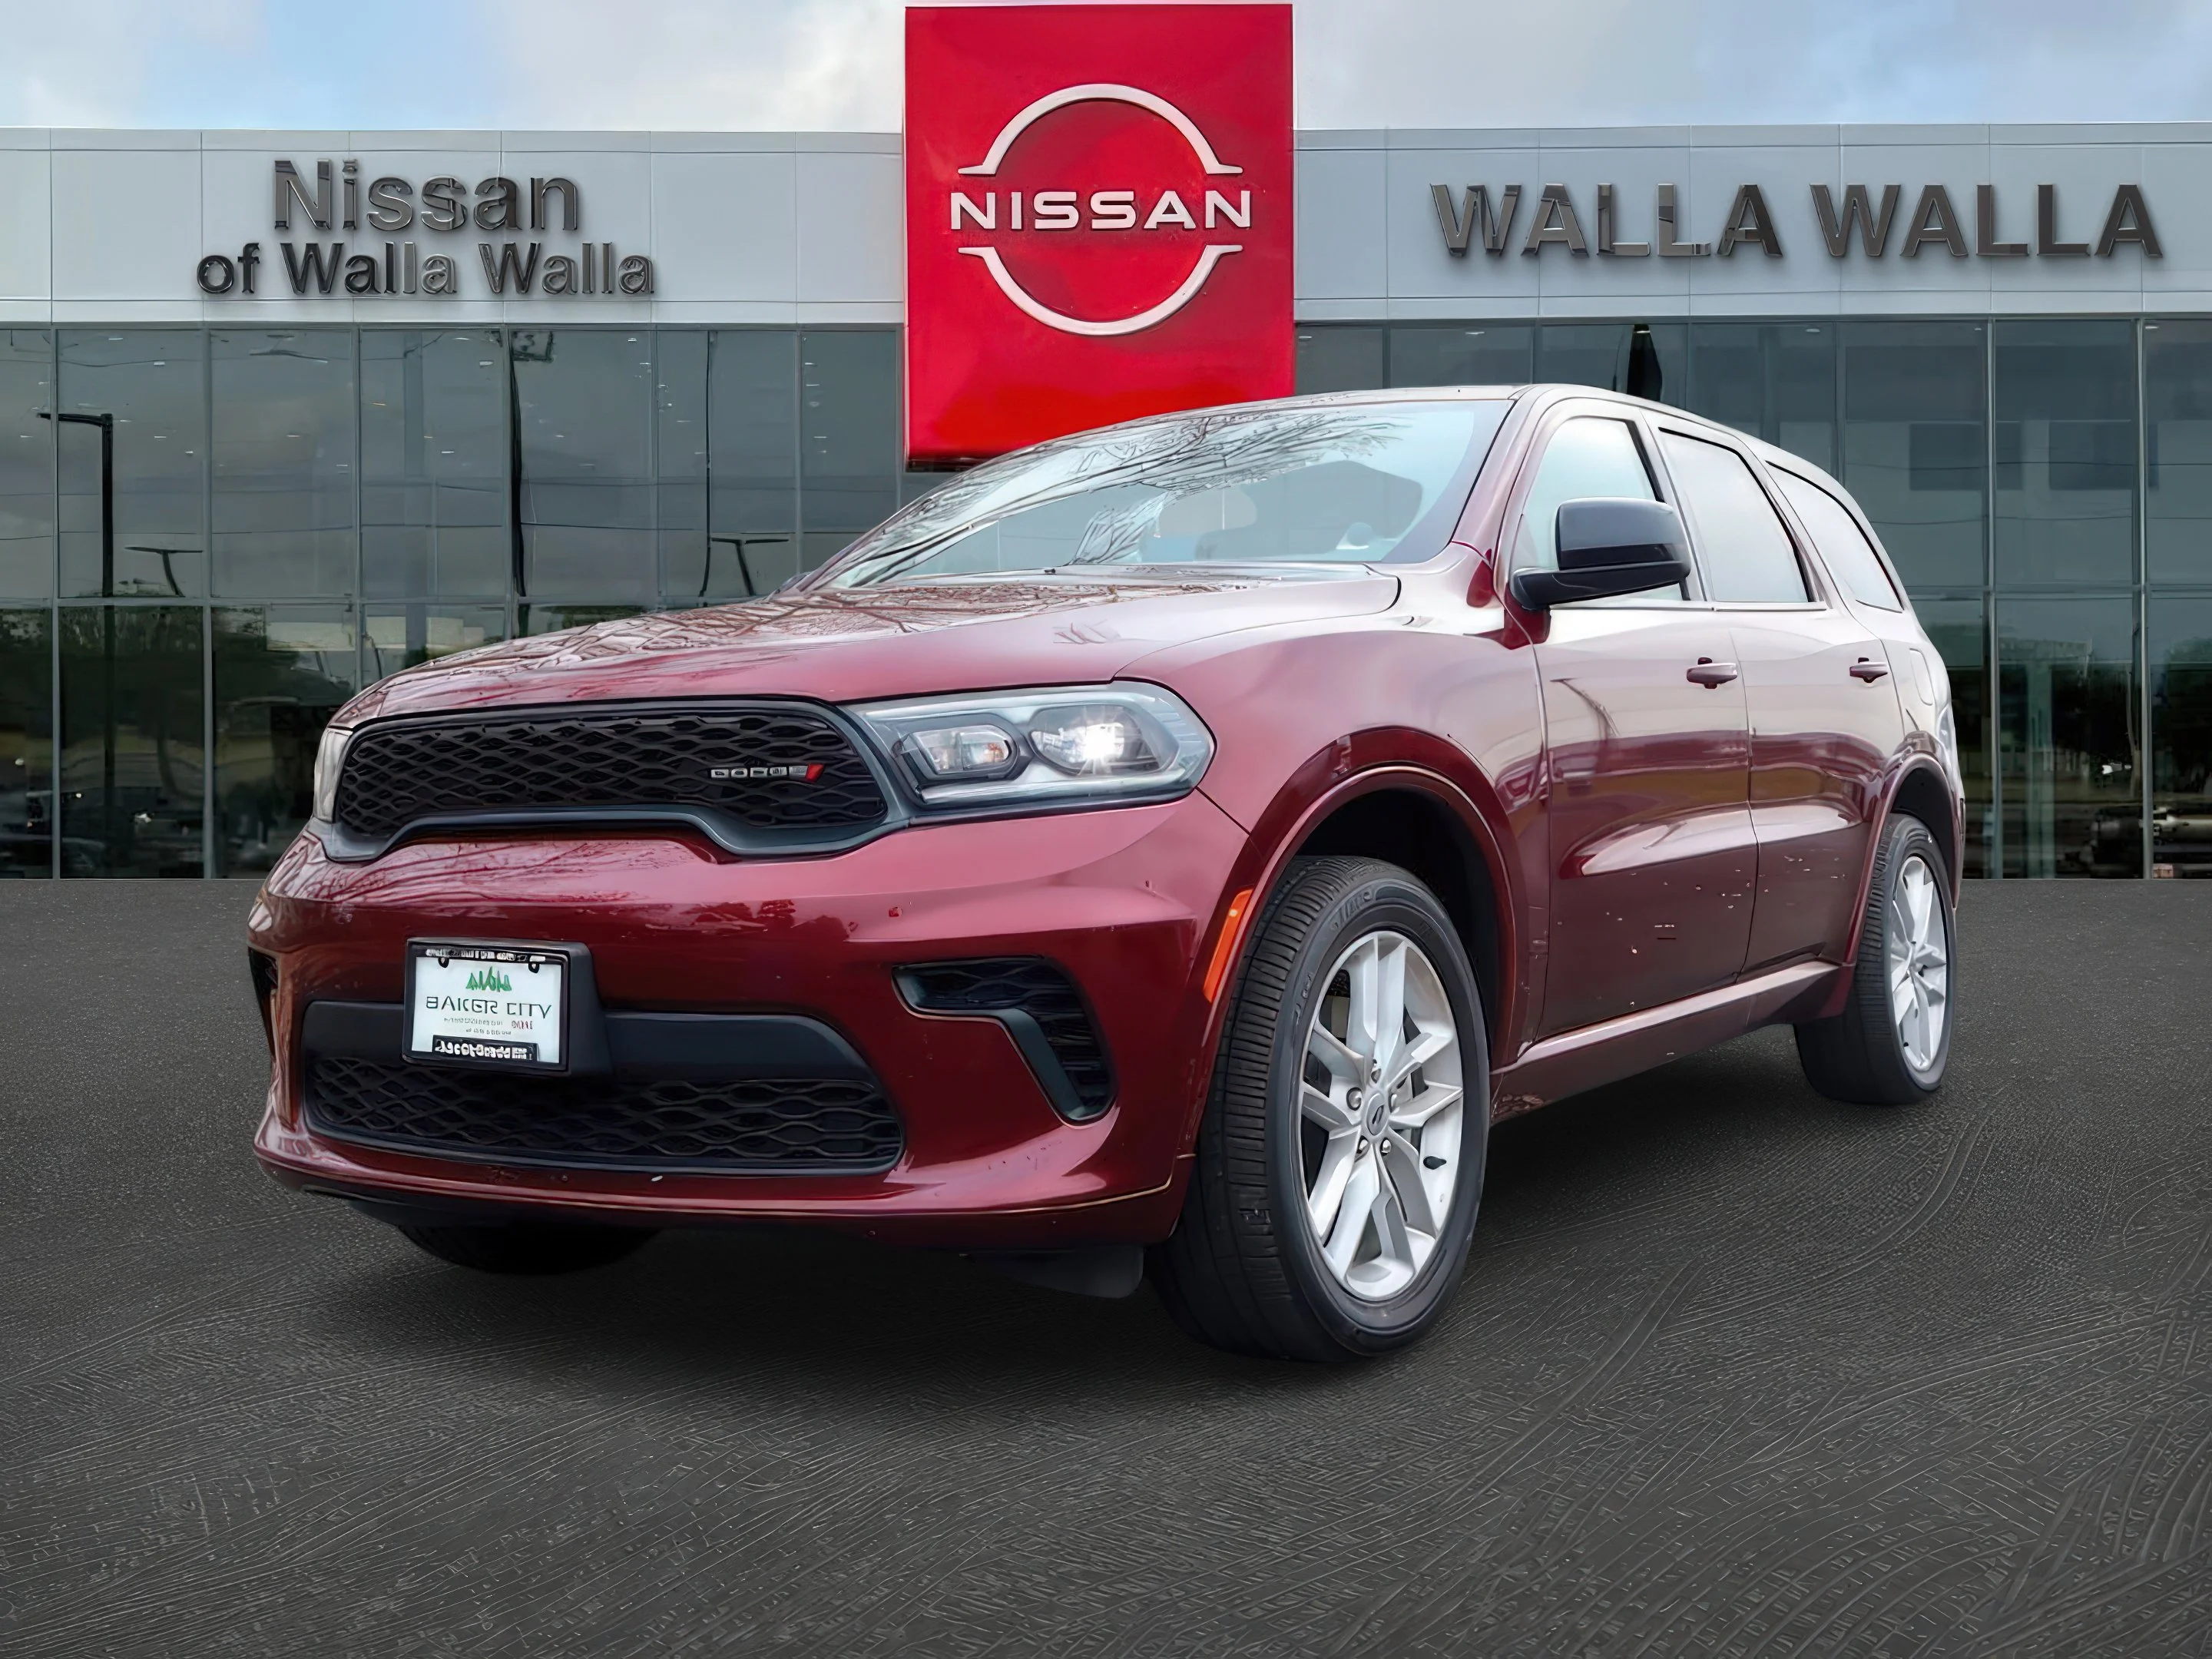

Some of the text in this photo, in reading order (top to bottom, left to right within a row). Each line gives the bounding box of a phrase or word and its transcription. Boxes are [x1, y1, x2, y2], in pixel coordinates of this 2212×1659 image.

[273, 158, 578, 230] Nissan
[951, 190, 1251, 229] NISSAN
[1429, 183, 2164, 257] WALLA WALLA
[196, 242, 655, 295] of Walla Walla
[507, 1002, 551, 1019] CITY
